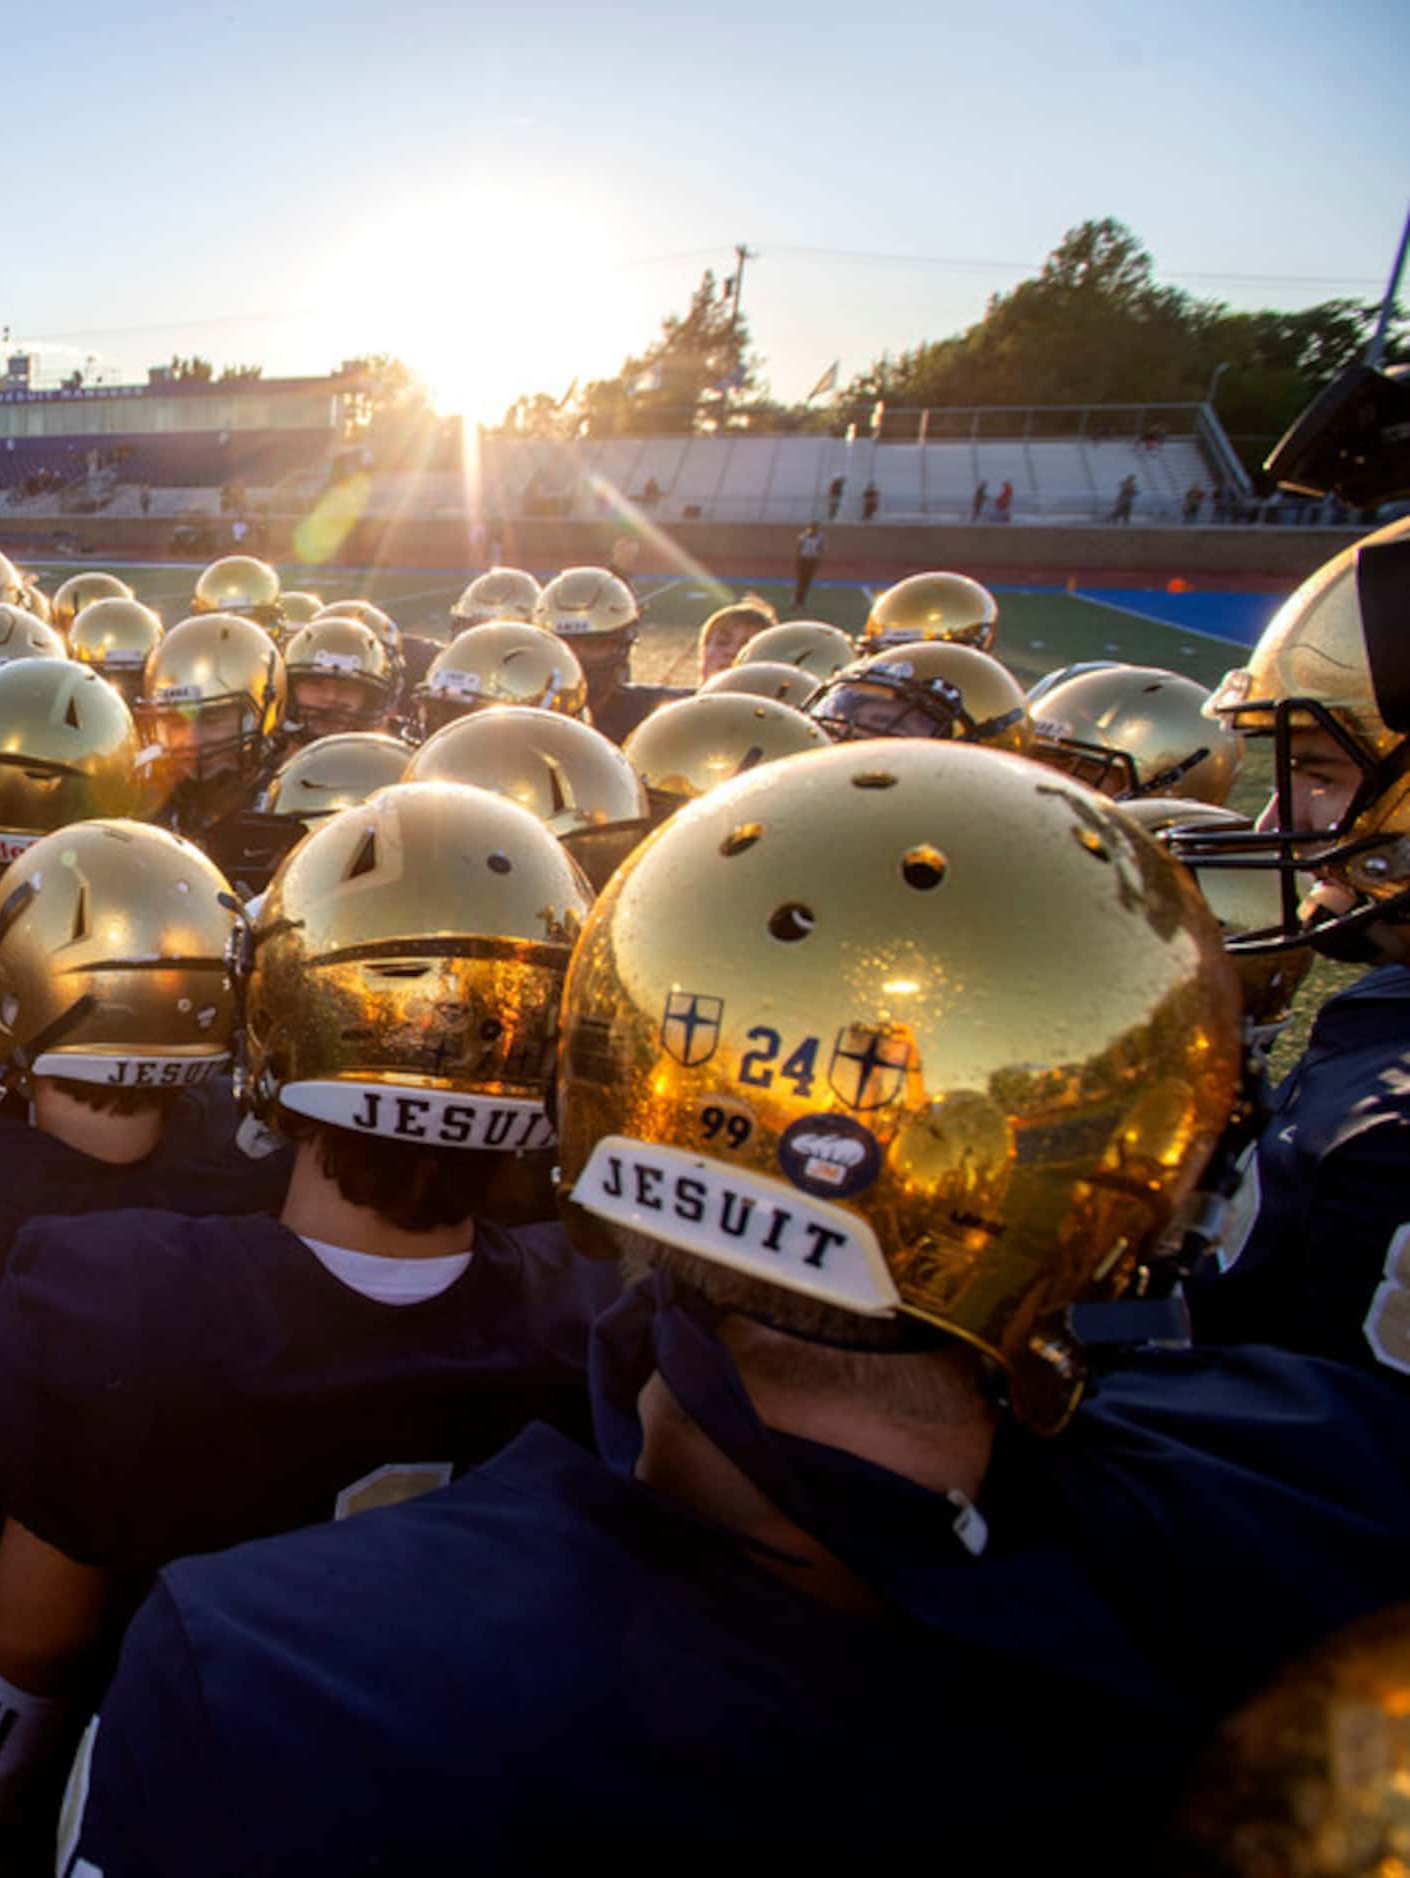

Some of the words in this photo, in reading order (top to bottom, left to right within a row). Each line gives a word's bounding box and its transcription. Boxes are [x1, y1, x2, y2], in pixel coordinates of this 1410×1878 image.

[107, 1060, 224, 1083] JESUI
[738, 1026, 819, 1098] 24
[353, 1092, 557, 1146] JESUI
[700, 1106, 752, 1149] 99
[602, 1157, 848, 1270] JESUIT
